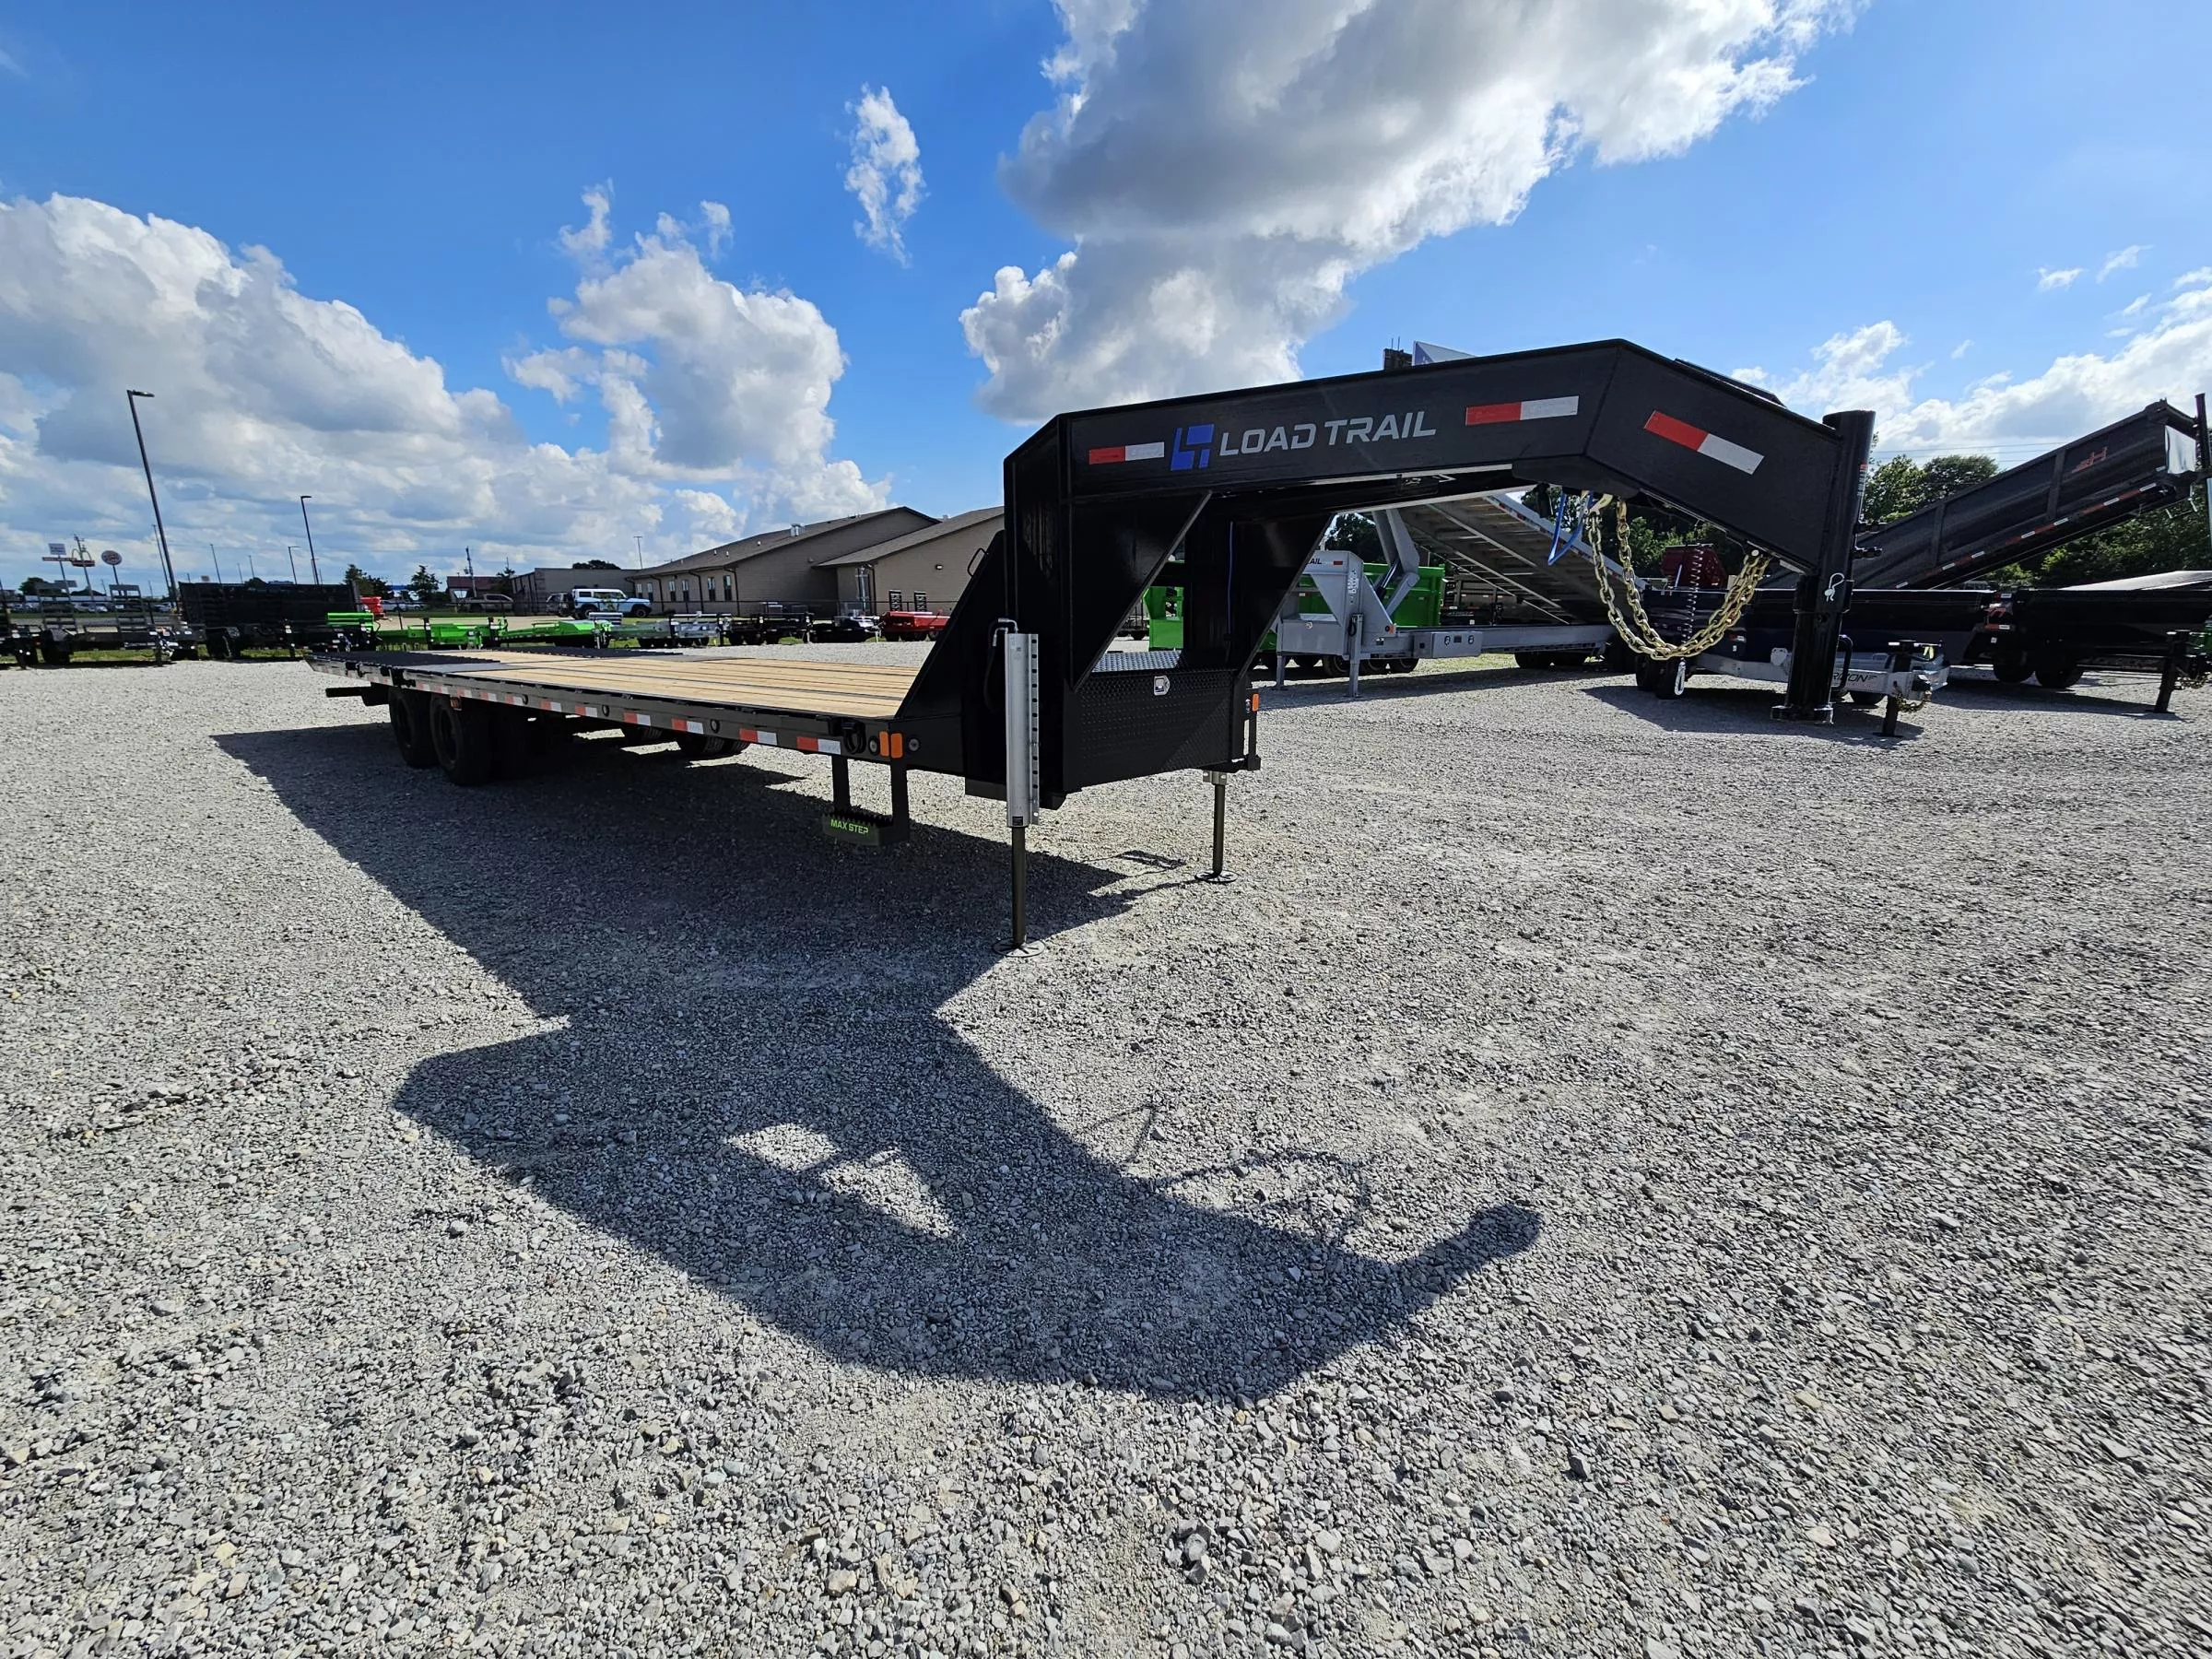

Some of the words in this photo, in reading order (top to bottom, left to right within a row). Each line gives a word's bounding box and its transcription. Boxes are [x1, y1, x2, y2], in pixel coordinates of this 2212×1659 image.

[1218, 423, 1317, 456] LOAD
[1324, 411, 1437, 446] TRAIL
[830, 818, 848, 830] MAX
[848, 823, 869, 834] STEP
